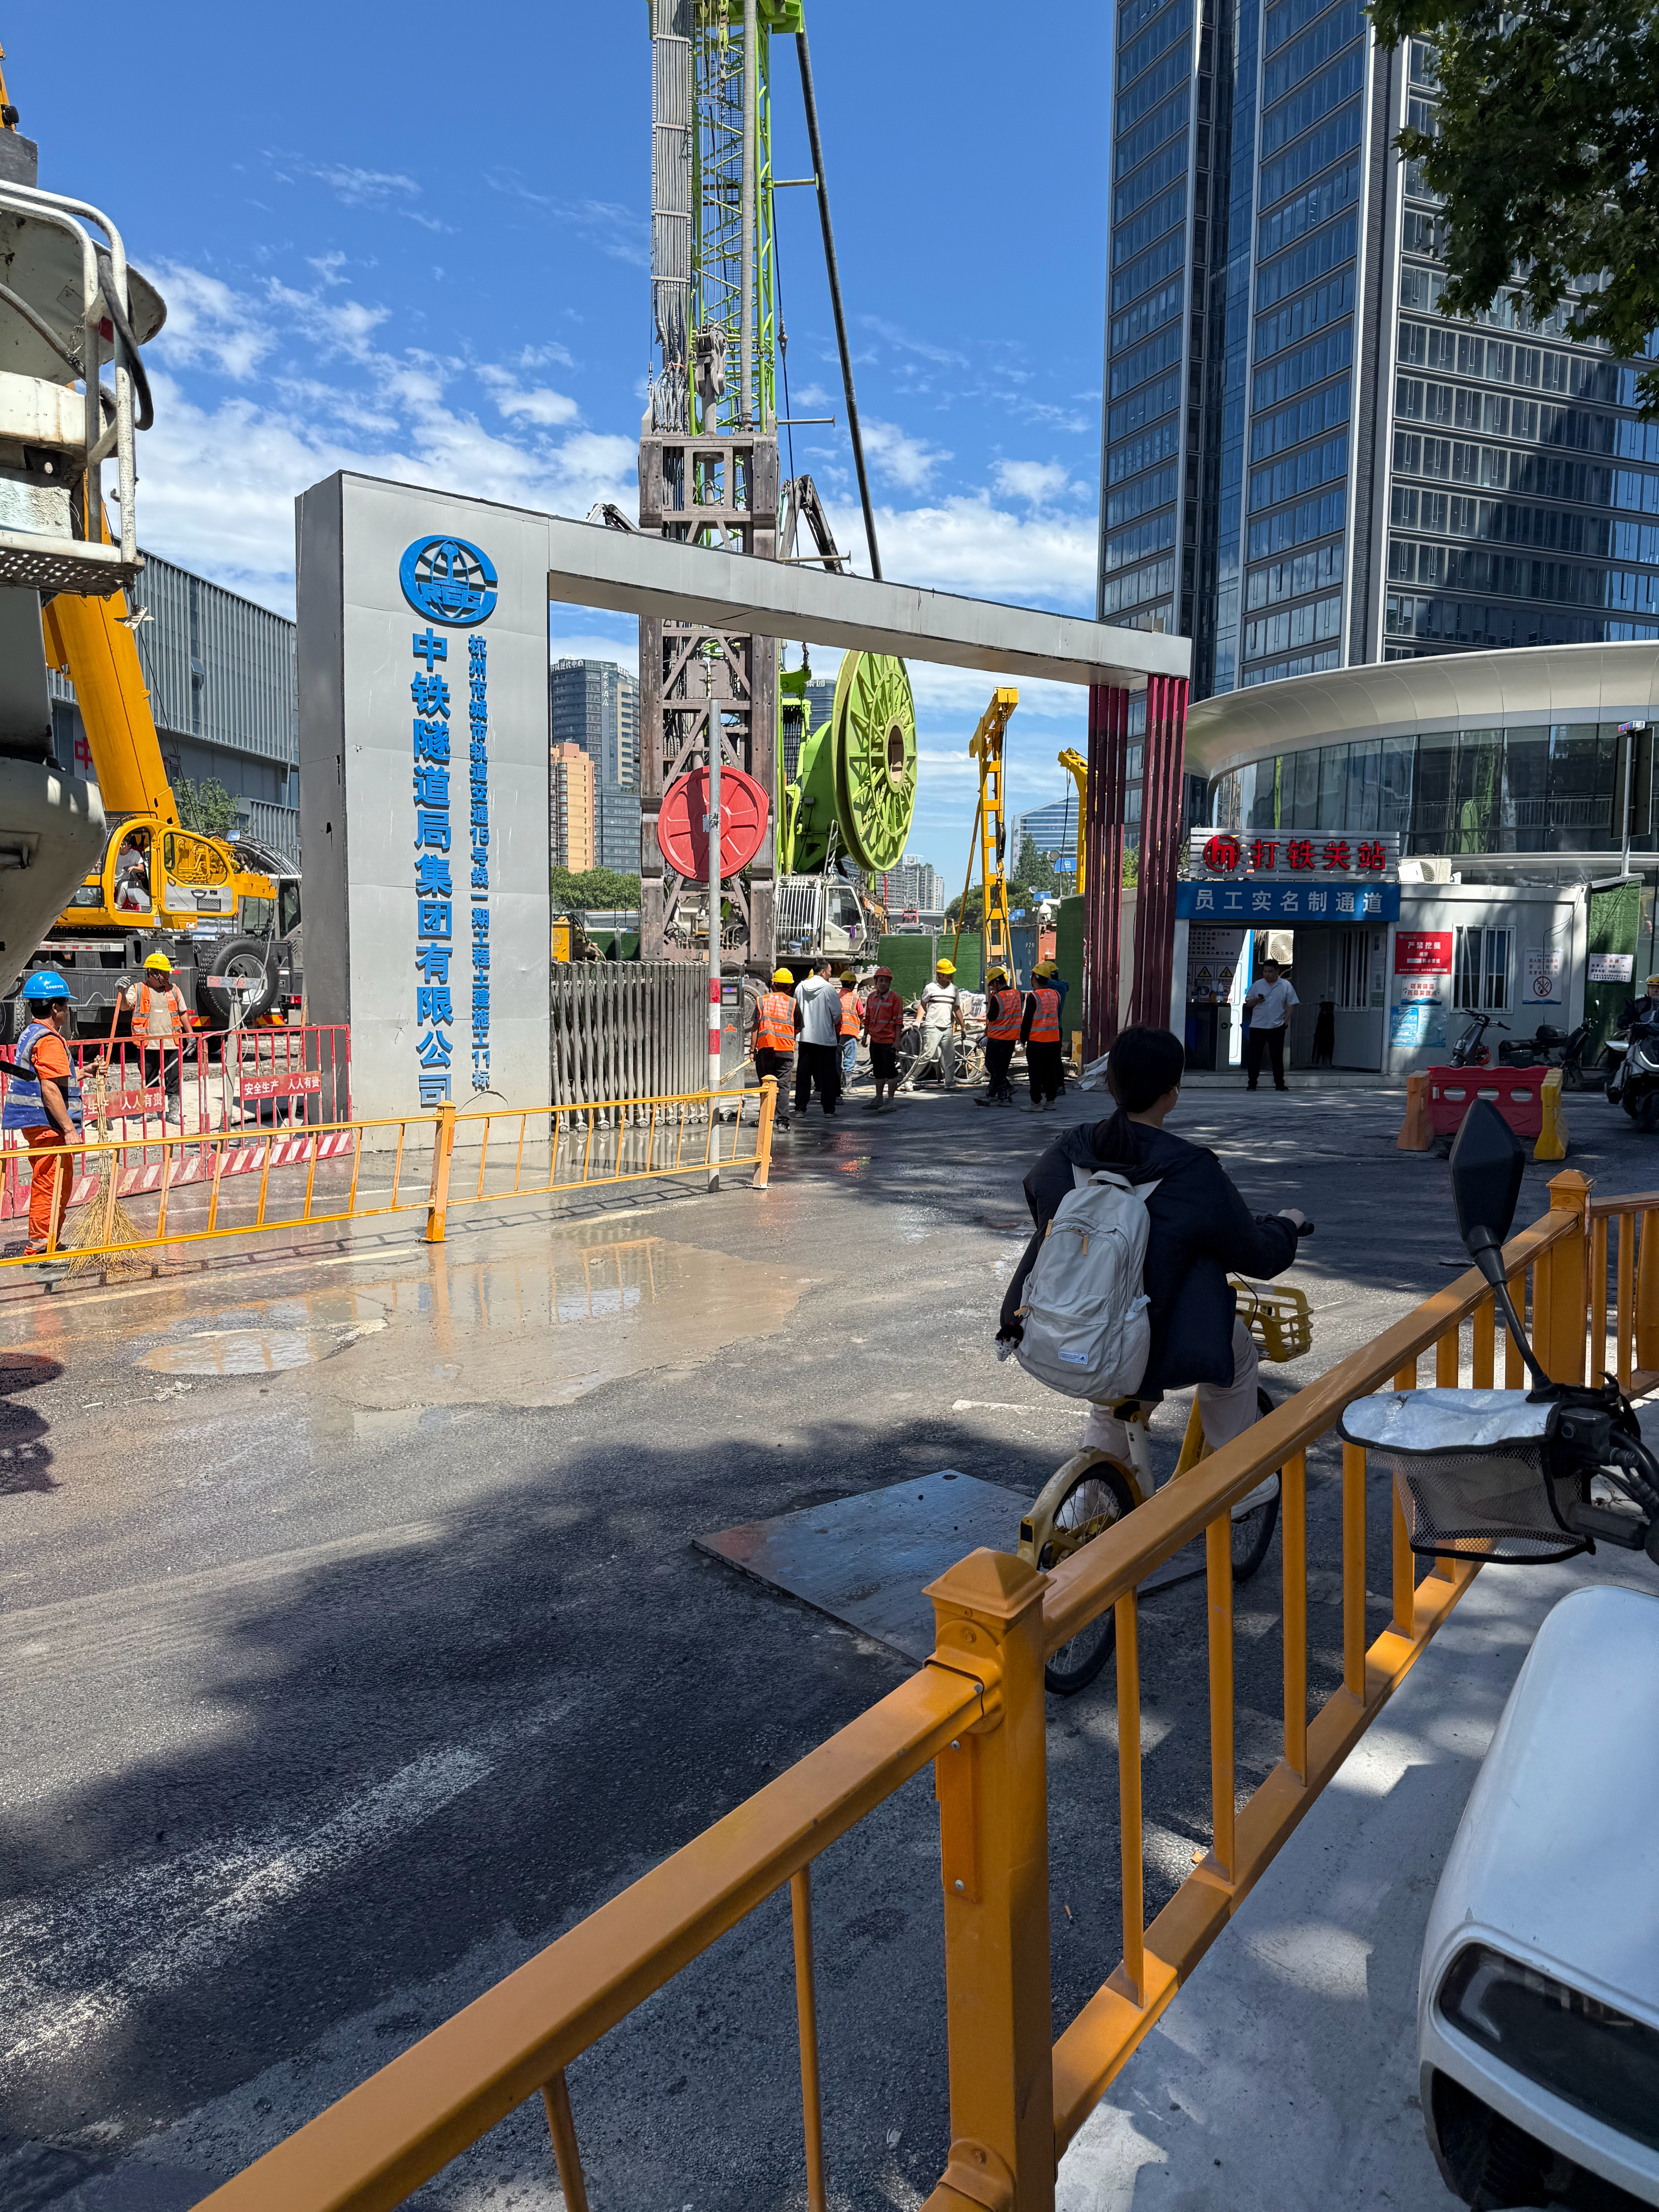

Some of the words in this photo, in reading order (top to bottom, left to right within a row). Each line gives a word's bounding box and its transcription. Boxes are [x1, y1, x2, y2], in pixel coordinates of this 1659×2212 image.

[411, 628, 453, 1108] 中铁隧道局集团有限公司
[469, 634, 491, 1091] 杭州市城市轨道交通15号线一期工程土建施工11标
[1251, 839, 1386, 870] 打铁关站
[1195, 890, 1382, 913] 员工实名制通道
[244, 1079, 279, 1096] 安全生产
[287, 1076, 320, 1091] 人人有责
[121, 1092, 163, 1110] 人人有责
